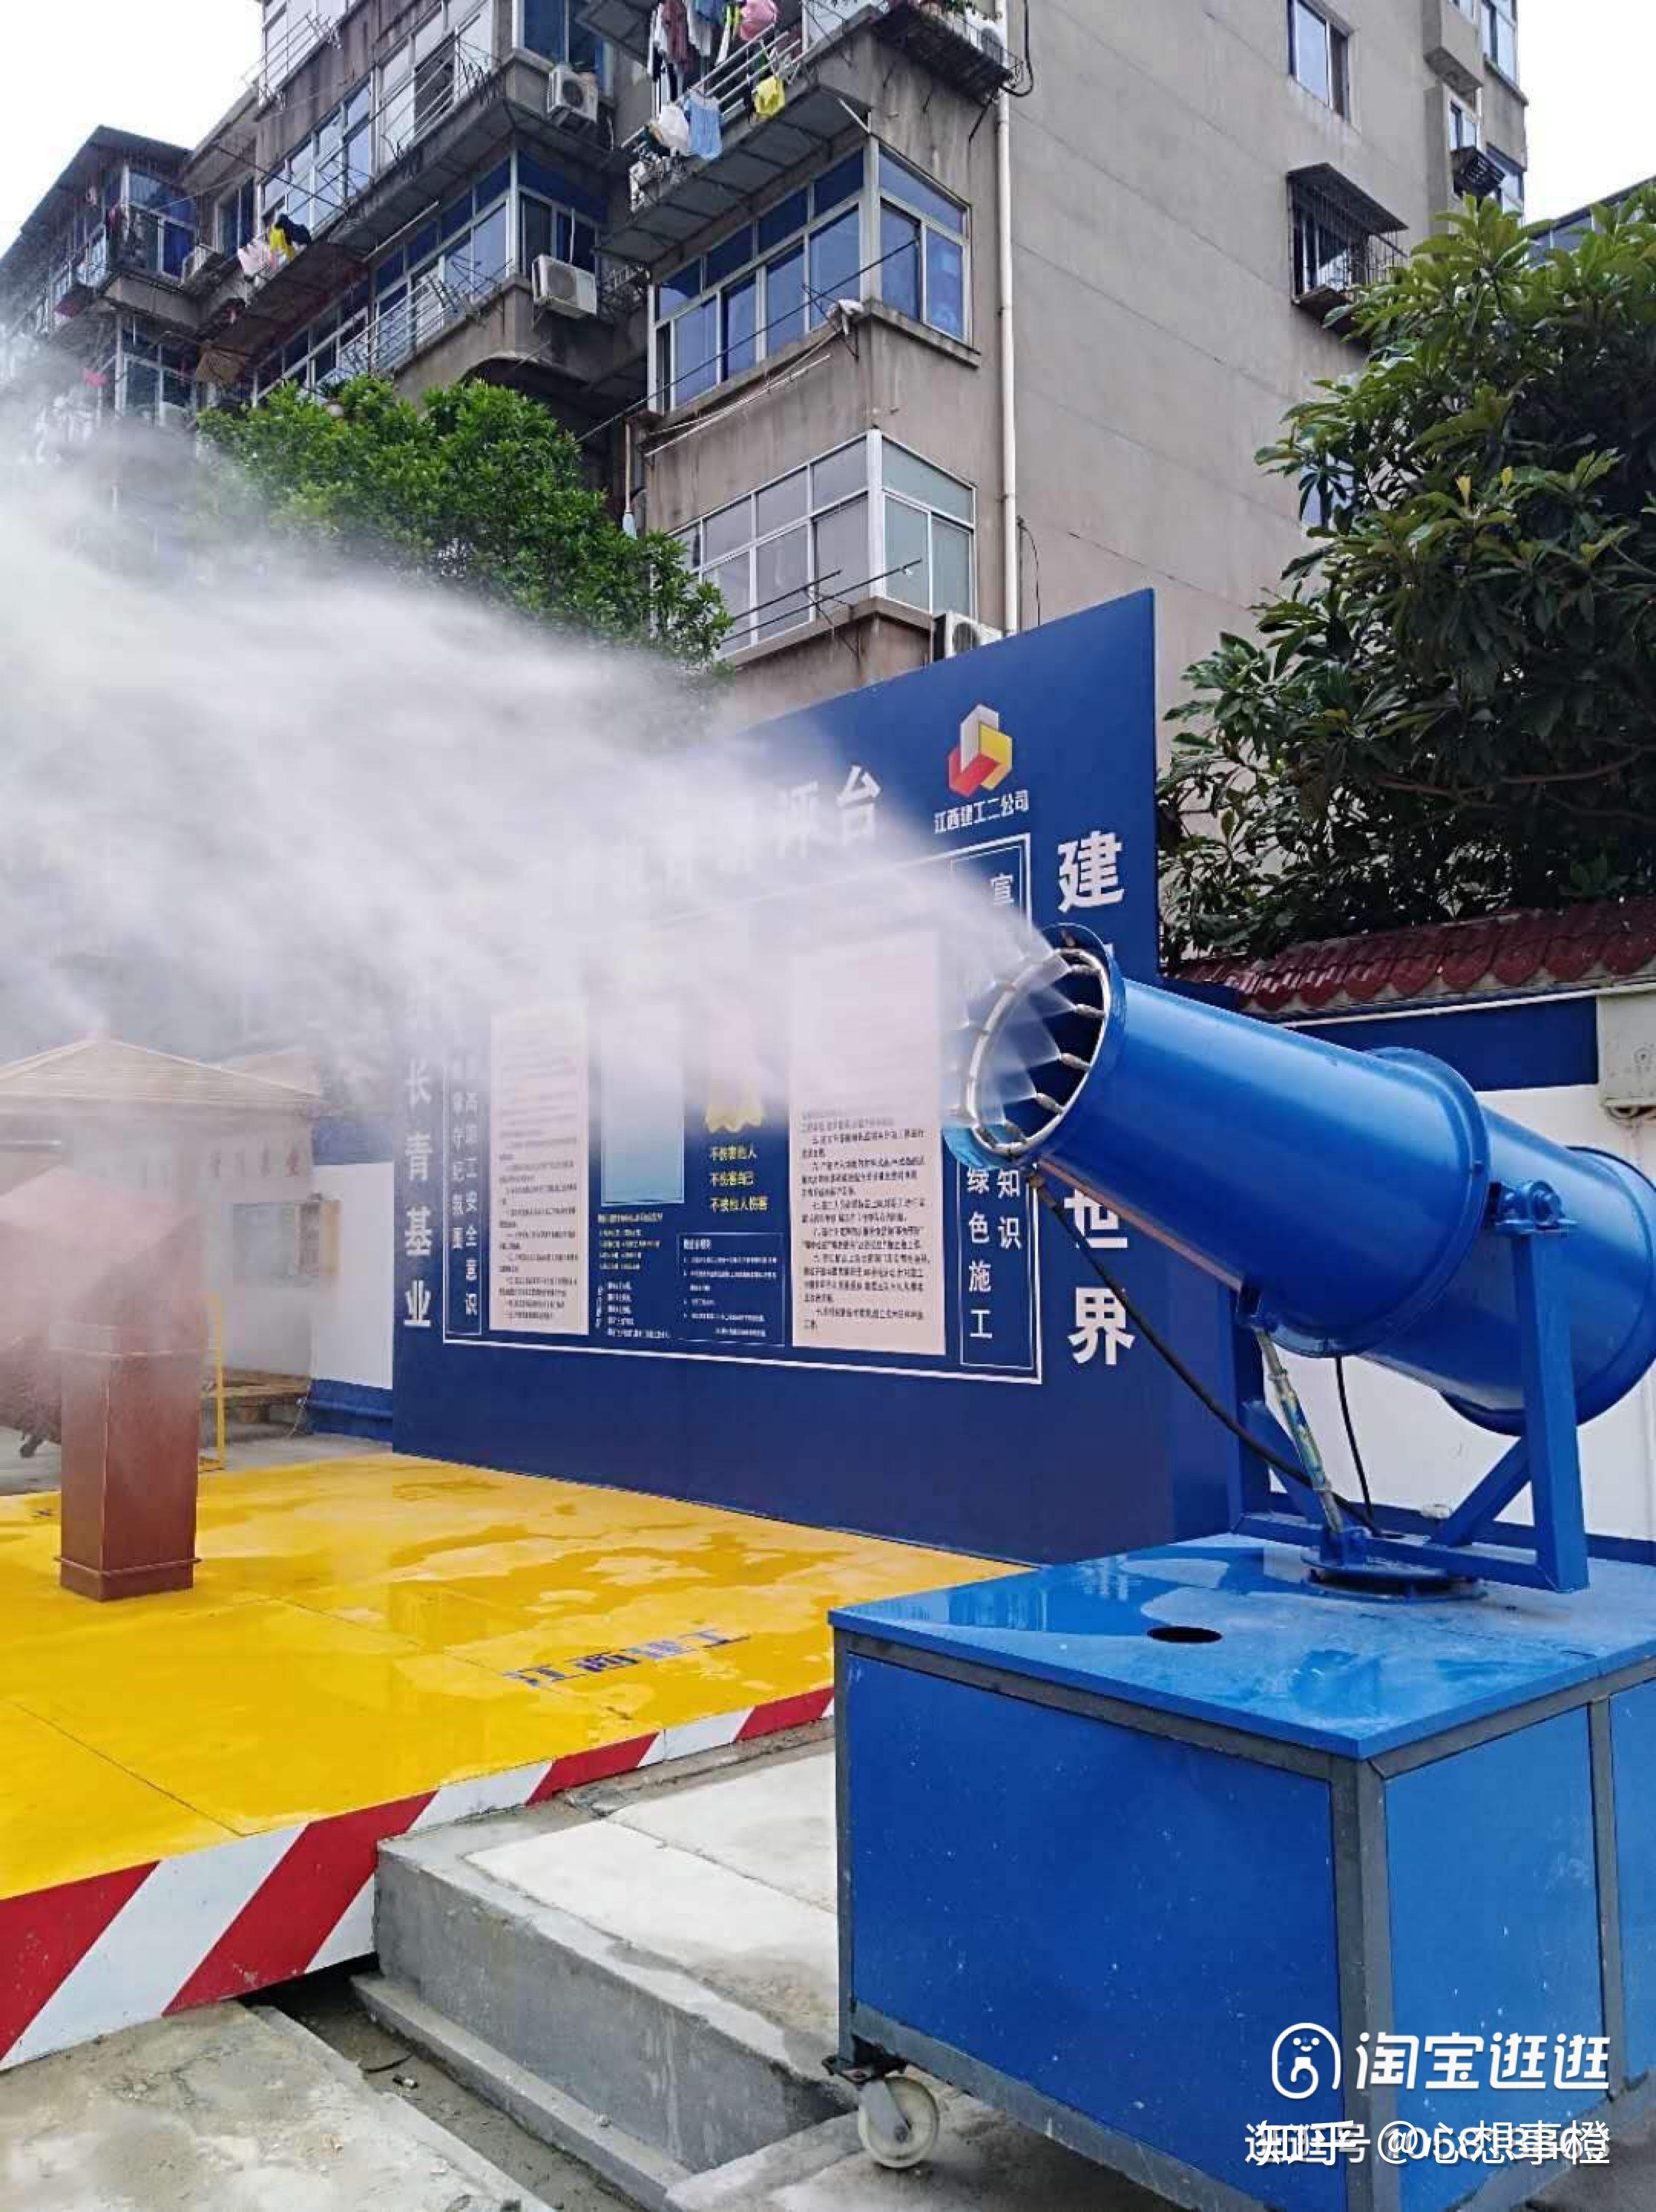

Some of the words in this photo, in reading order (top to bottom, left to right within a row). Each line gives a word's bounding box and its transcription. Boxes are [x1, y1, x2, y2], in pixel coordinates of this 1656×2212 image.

[934, 789, 1030, 834] 江西建工二公司
